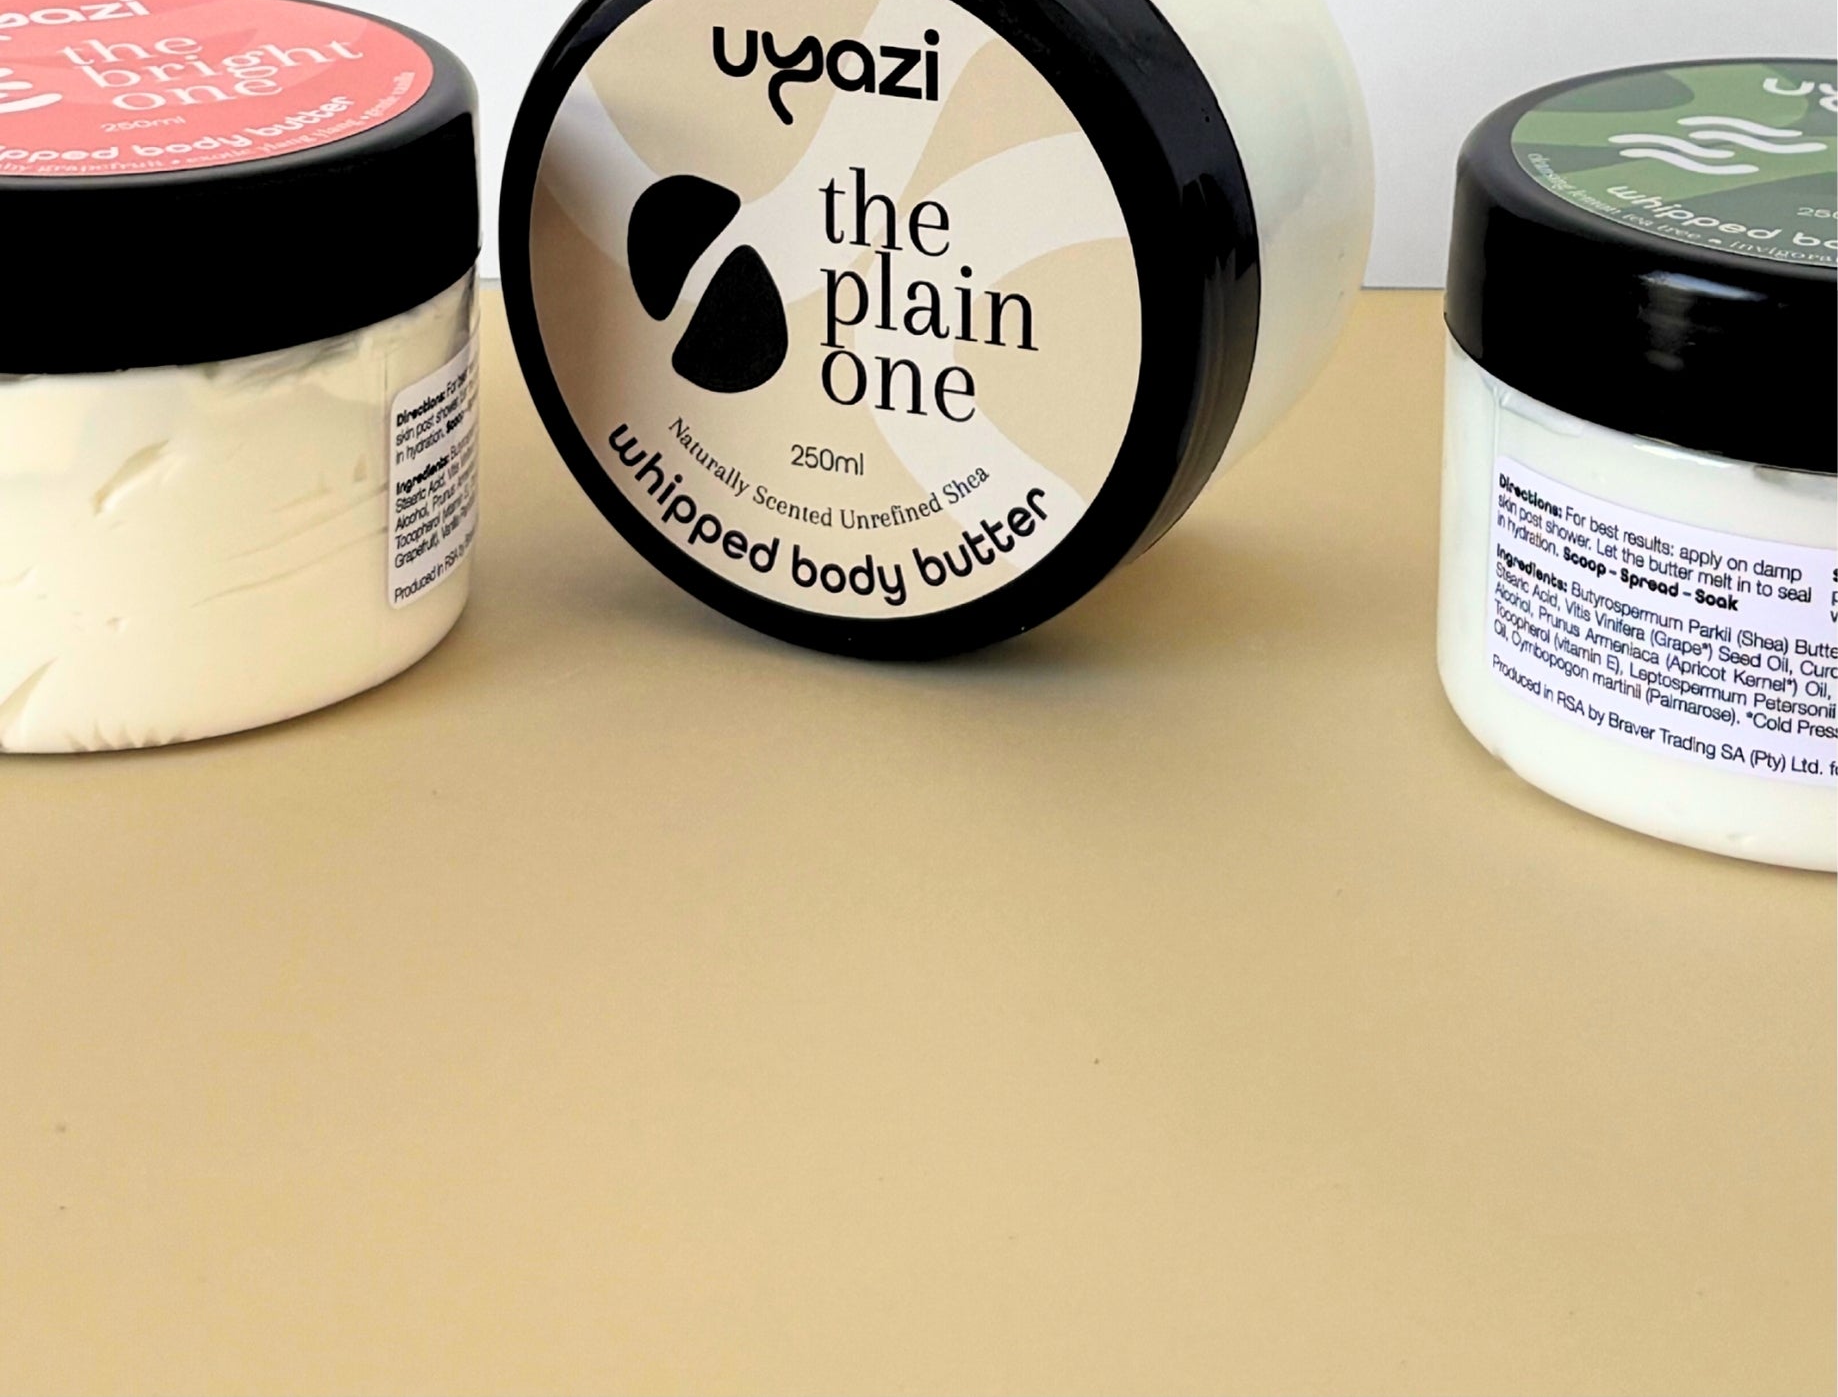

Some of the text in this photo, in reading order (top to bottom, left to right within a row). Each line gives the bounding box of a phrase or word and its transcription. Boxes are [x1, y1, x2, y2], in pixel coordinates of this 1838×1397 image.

[58, 37, 203, 64] the
[75, 37, 364, 88] bright
[112, 78, 283, 110] one
[713, 26, 939, 125] uyazi
[101, 116, 186, 133] 250ml
[132, 134, 253, 157] body
[246, 96, 355, 136] butter
[819, 167, 950, 257] the
[1607, 185, 1782, 240] whipped
[820, 250, 1039, 351] plain
[821, 350, 976, 423] one
[668, 416, 990, 530] Naturally Scented Unrefined Shea
[791, 444, 864, 476] 250ml
[608, 423, 1048, 606] whipped body butter
[1497, 510, 1505, 527] in
[1507, 516, 1559, 557] hydration.
[1563, 546, 1606, 578] Scoop
[1620, 568, 1679, 598] Spread
[1695, 588, 1739, 611] Soak
[1498, 493, 1517, 516] skin
[1519, 507, 1543, 530] post
[1545, 519, 1592, 550] shower.
[1596, 538, 1618, 561] Let
[1622, 547, 1645, 568] the
[1649, 552, 1694, 580] butter
[1697, 570, 1732, 590] melt
[1737, 576, 1751, 593] in
[1756, 580, 1773, 597] to
[1778, 586, 1812, 603] seal
[1499, 472, 1562, 519] Directions:
[1565, 505, 1586, 528] For
[1590, 516, 1619, 541] best
[1623, 531, 1674, 557] results:
[1679, 547, 1723, 570] apply
[1727, 557, 1748, 572] on
[1753, 559, 1803, 584] damp
[1496, 542, 1568, 592] Ingredients:
[1571, 581, 1683, 632] Butyrospermum
[1737, 629, 1789, 655] (Shea)
[1496, 561, 1529, 594] Stearic
[1565, 597, 1591, 622] Vitis
[1594, 610, 1646, 641] Vinifera
[1718, 645, 1762, 668] Seed
[1767, 655, 1793, 676] Oil,
[1494, 598, 1837, 720] Tocopherol (vitamin E), Leptospermum Petersonii
[1538, 605, 1580, 637] Prunus
[1585, 627, 1660, 665] Armeniaca
[1665, 653, 1727, 682] (Apricot
[1805, 680, 1831, 701] Oil,
[1492, 653, 1541, 696] Produced
[1543, 683, 1554, 703] in
[1557, 690, 1585, 716] RSA
[1588, 704, 1606, 726] by
[1608, 711, 1656, 740] Braver
[1658, 727, 1716, 760] Trading
[1720, 743, 1745, 763] SA
[1750, 749, 1787, 773] (Pty)
[1791, 755, 1823, 775] Ltd.
[1645, 686, 1741, 727] (Palmarose).
